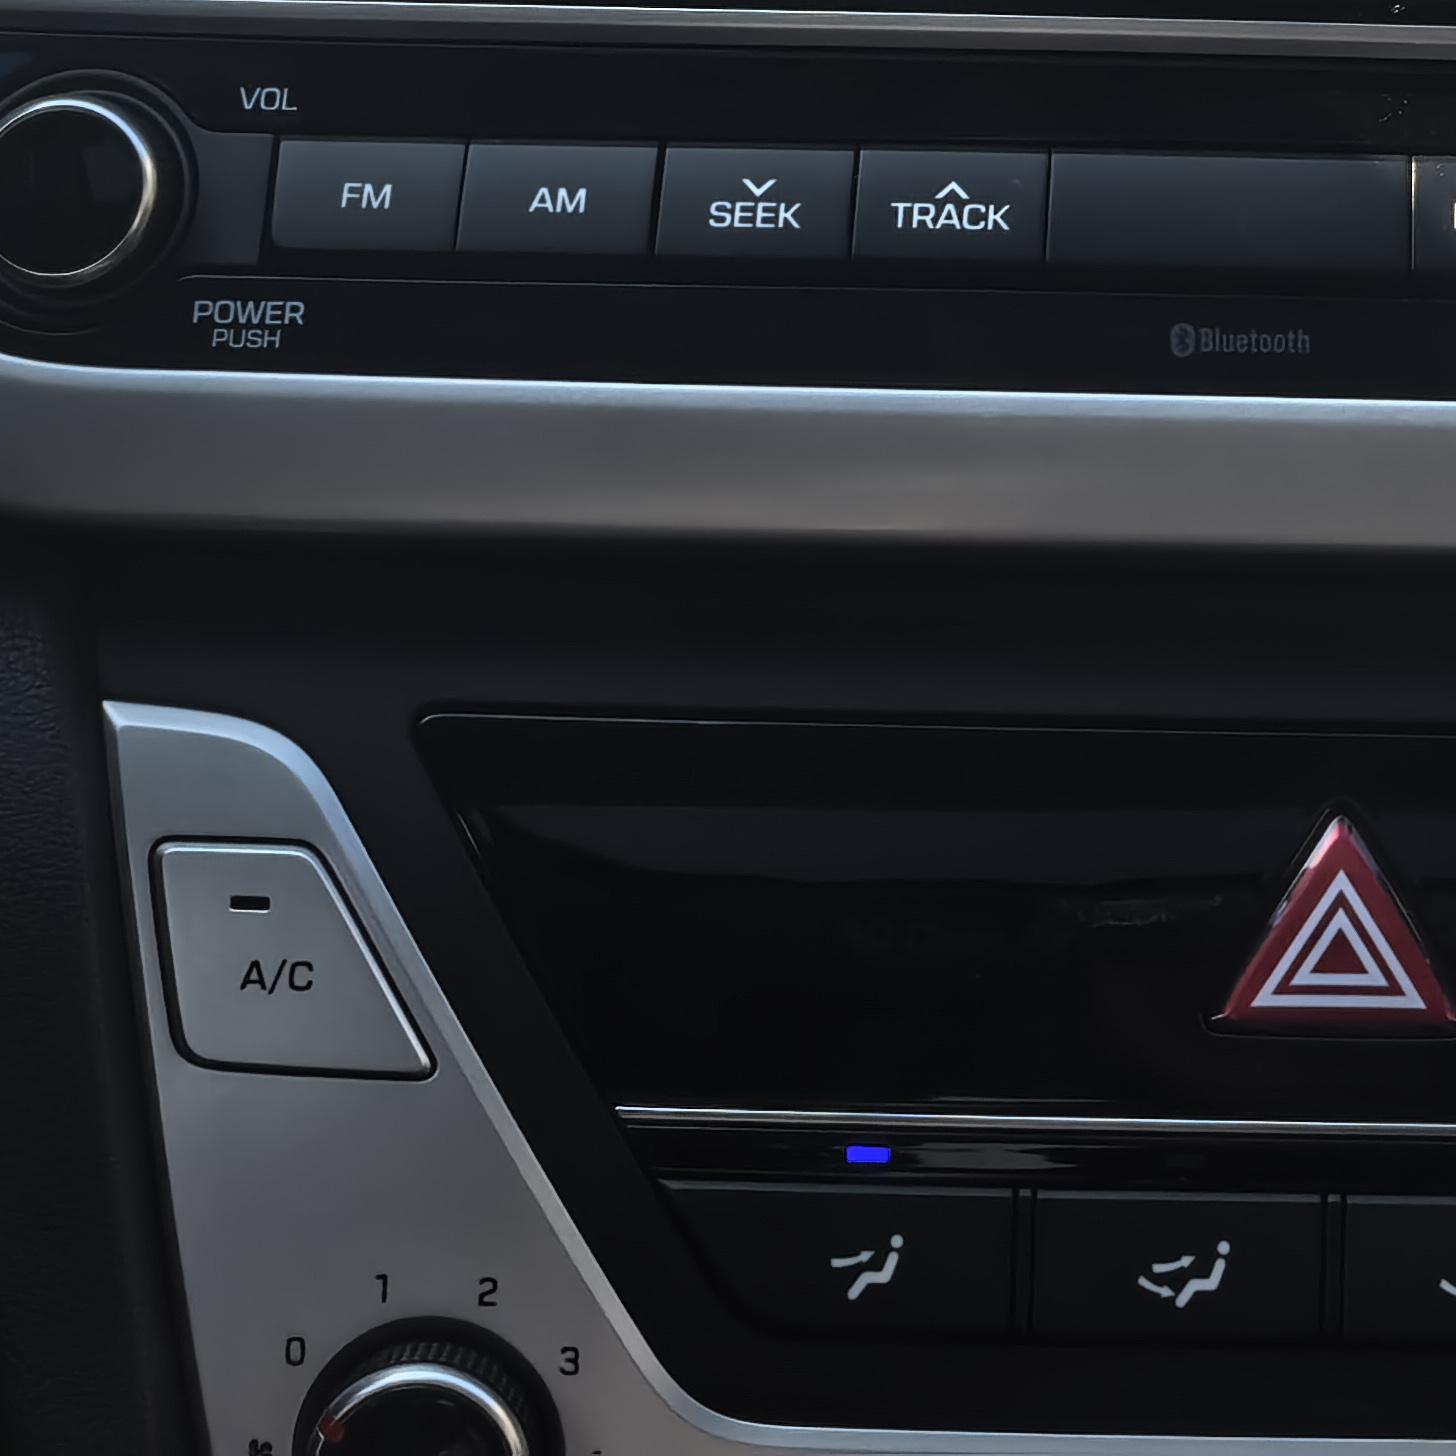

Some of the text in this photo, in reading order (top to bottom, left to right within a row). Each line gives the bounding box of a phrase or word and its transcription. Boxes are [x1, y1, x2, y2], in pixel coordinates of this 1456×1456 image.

[238, 86, 299, 112] VOL
[340, 181, 394, 210] FM
[527, 185, 588, 215] AM
[707, 199, 802, 231] SEEK
[889, 201, 1011, 232] TRACK
[191, 298, 306, 326] POWER
[210, 327, 282, 350] PUSH
[1199, 327, 1311, 355] Bluetooth
[238, 957, 315, 996] A/C
[374, 1272, 390, 1305] 1
[476, 1275, 499, 1308] 2
[283, 1335, 307, 1368] 0
[558, 1345, 581, 1377] 3
